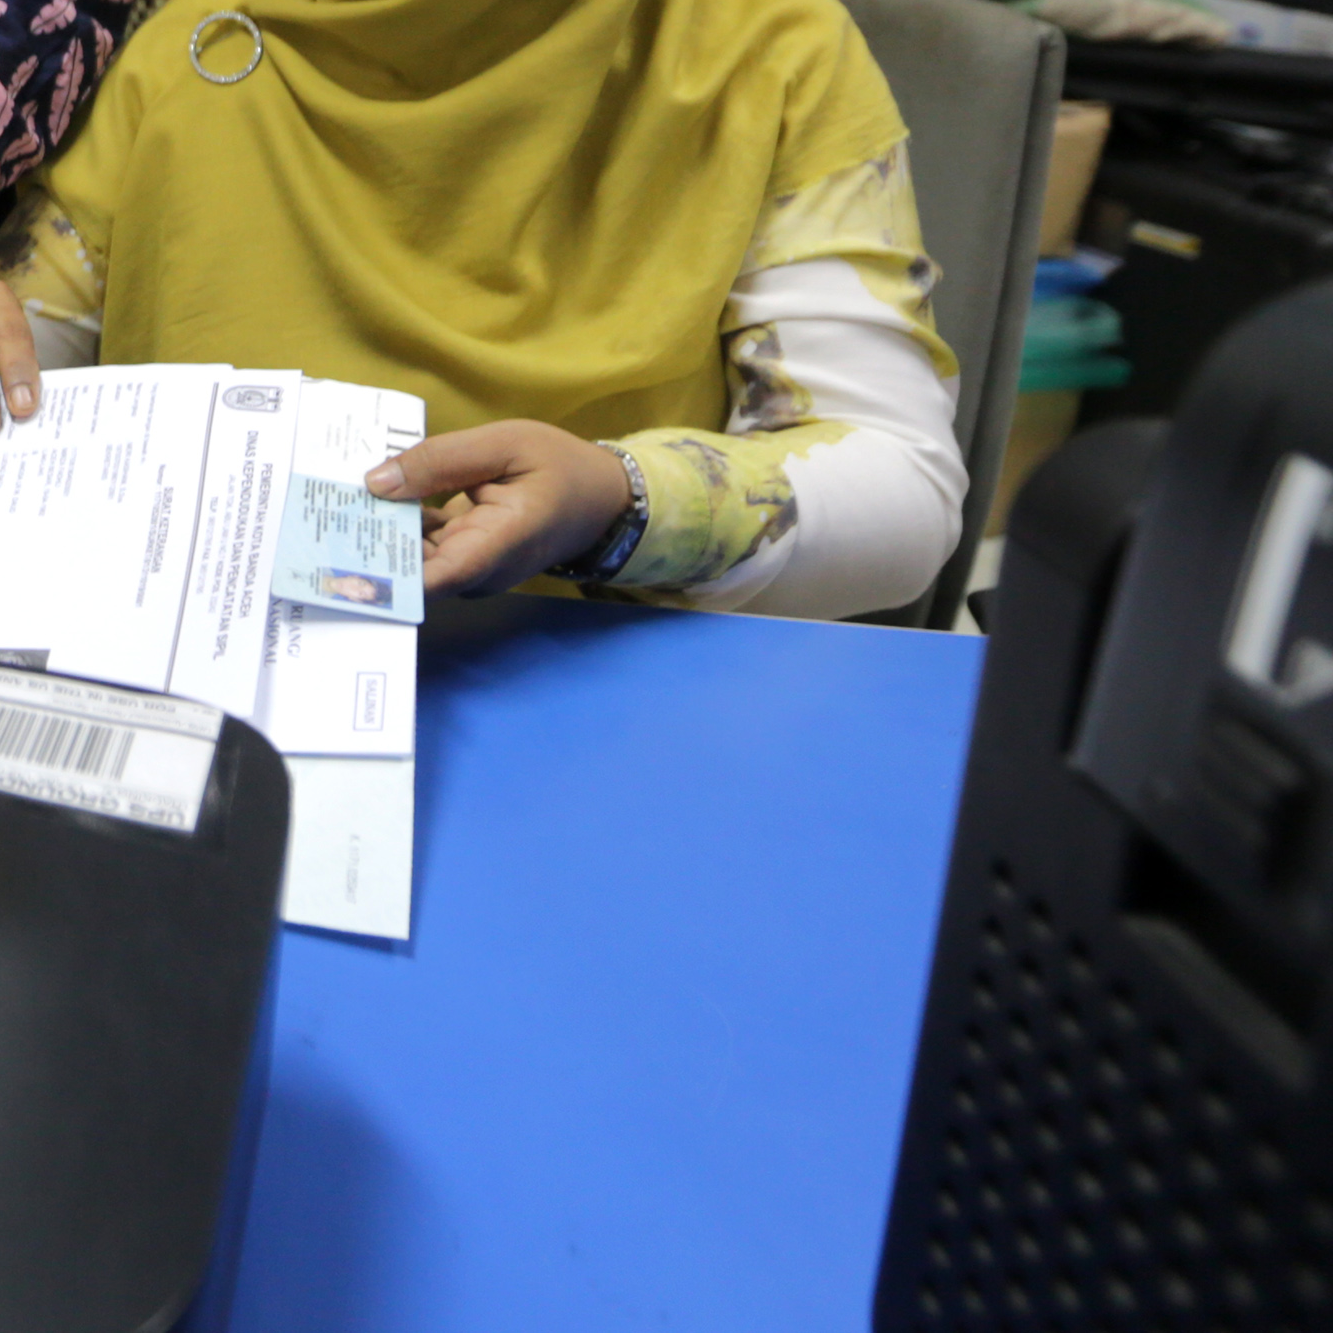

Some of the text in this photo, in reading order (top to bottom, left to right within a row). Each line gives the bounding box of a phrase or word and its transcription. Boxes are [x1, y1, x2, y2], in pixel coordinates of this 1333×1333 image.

[245, 430, 259, 457] DINAS
[234, 460, 255, 540] KEPENDUDUKAN
[151, 487, 175, 574] SURAT KETERANGAN
[230, 541, 244, 563] DAN
[239, 463, 274, 619] PEMERINTAH KOTA BANDA ACEH
[218, 564, 241, 631] PENCATATAN
[213, 633, 229, 660] SIPIL
[129, 802, 186, 826] UPS
